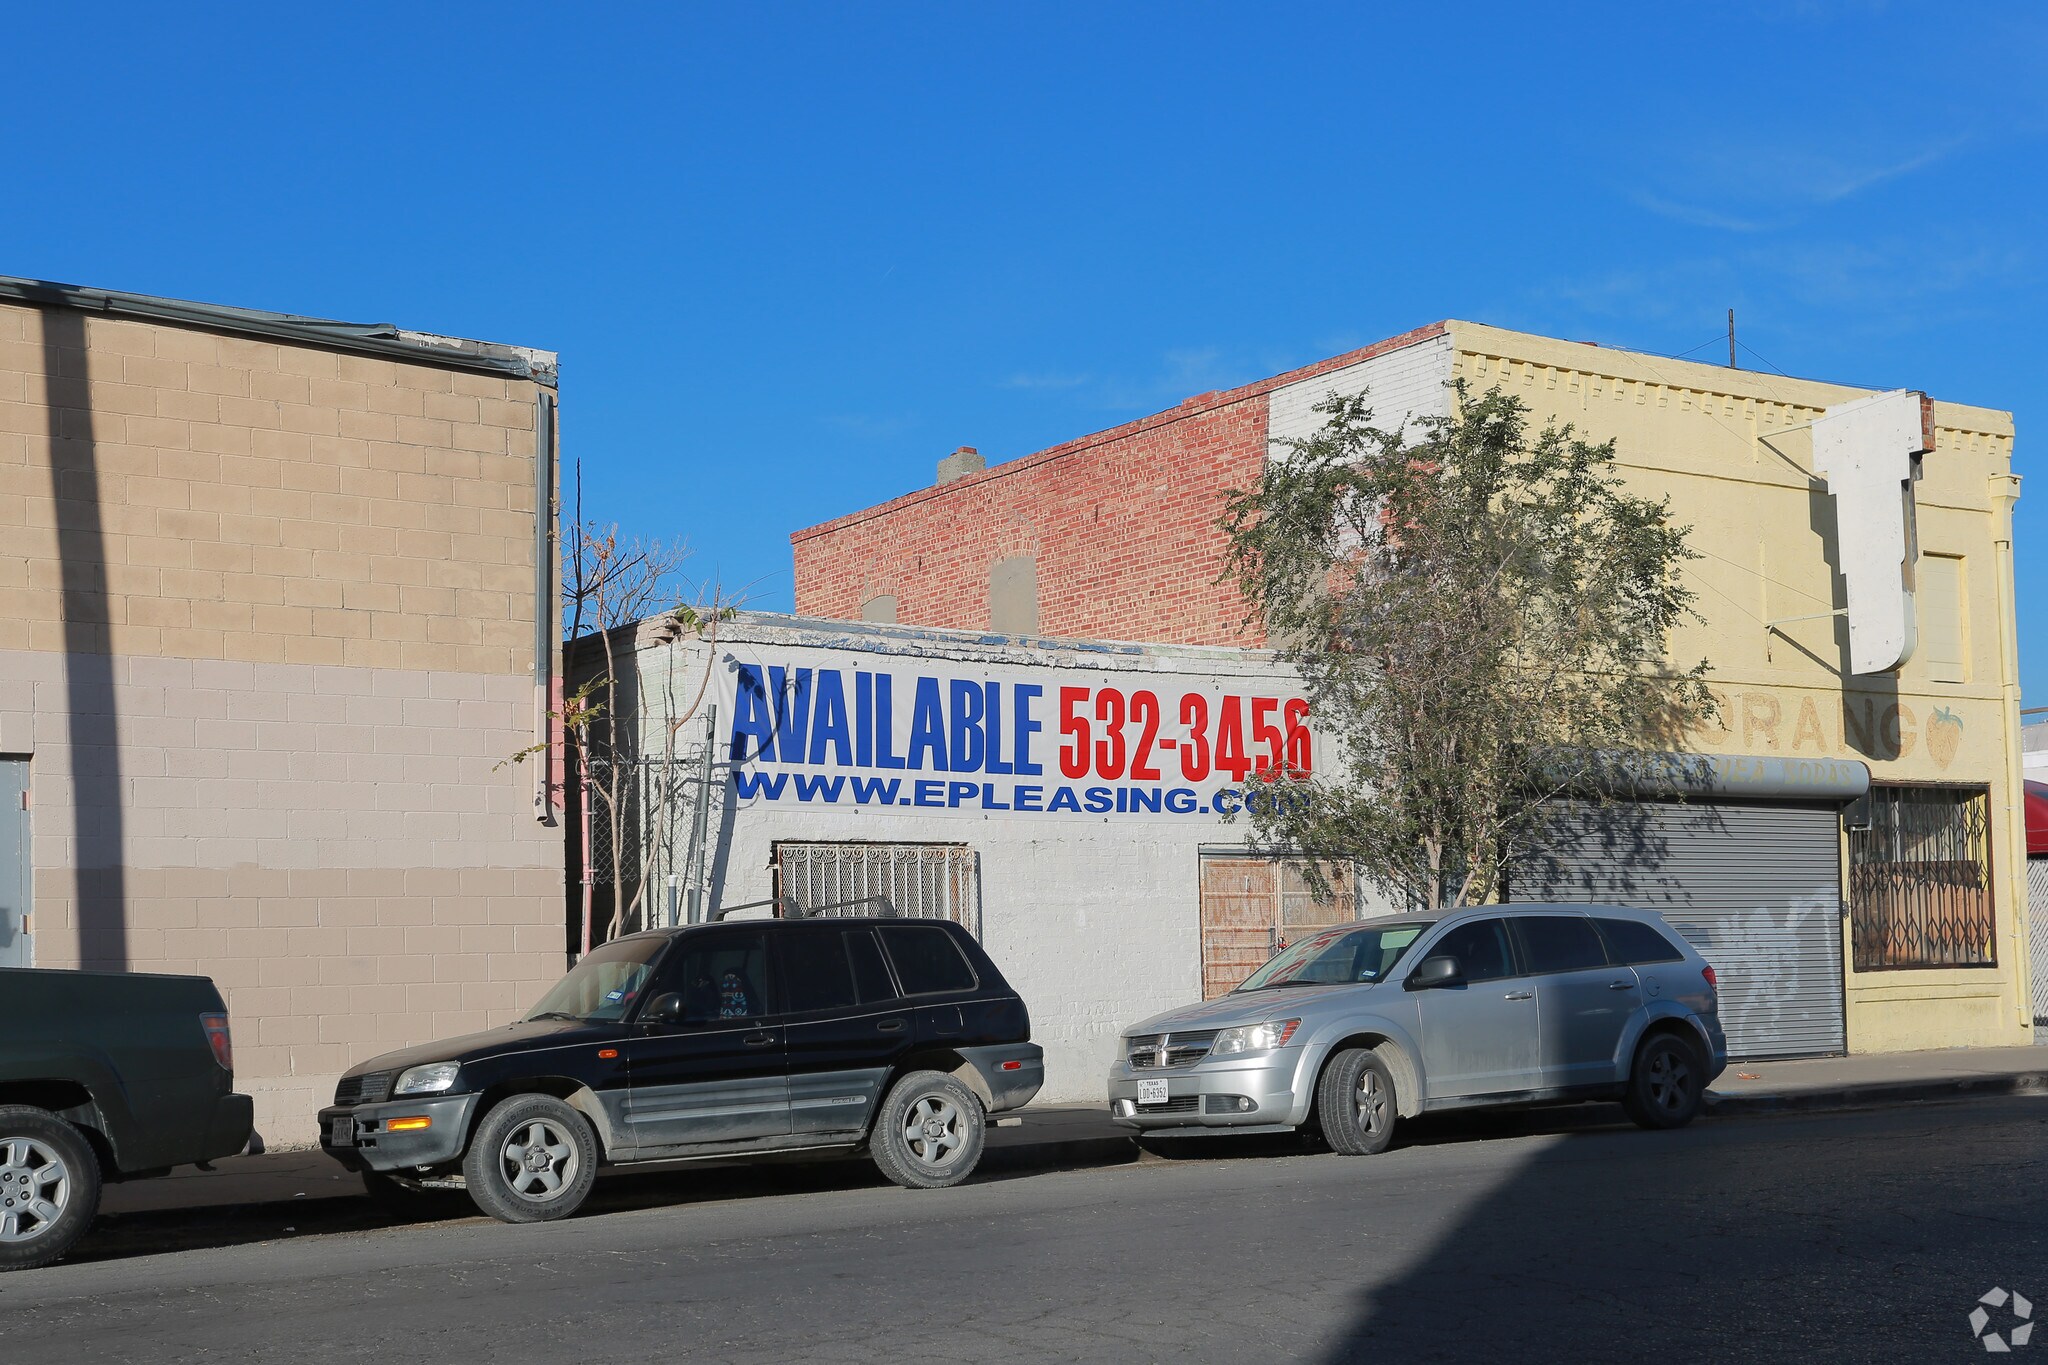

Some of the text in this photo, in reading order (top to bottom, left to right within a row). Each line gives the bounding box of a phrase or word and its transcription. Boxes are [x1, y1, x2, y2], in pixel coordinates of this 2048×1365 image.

[729, 663, 1312, 783] AVAILABLE 532-3456
[576, 1125, 593, 1194] CONTINENTAL
